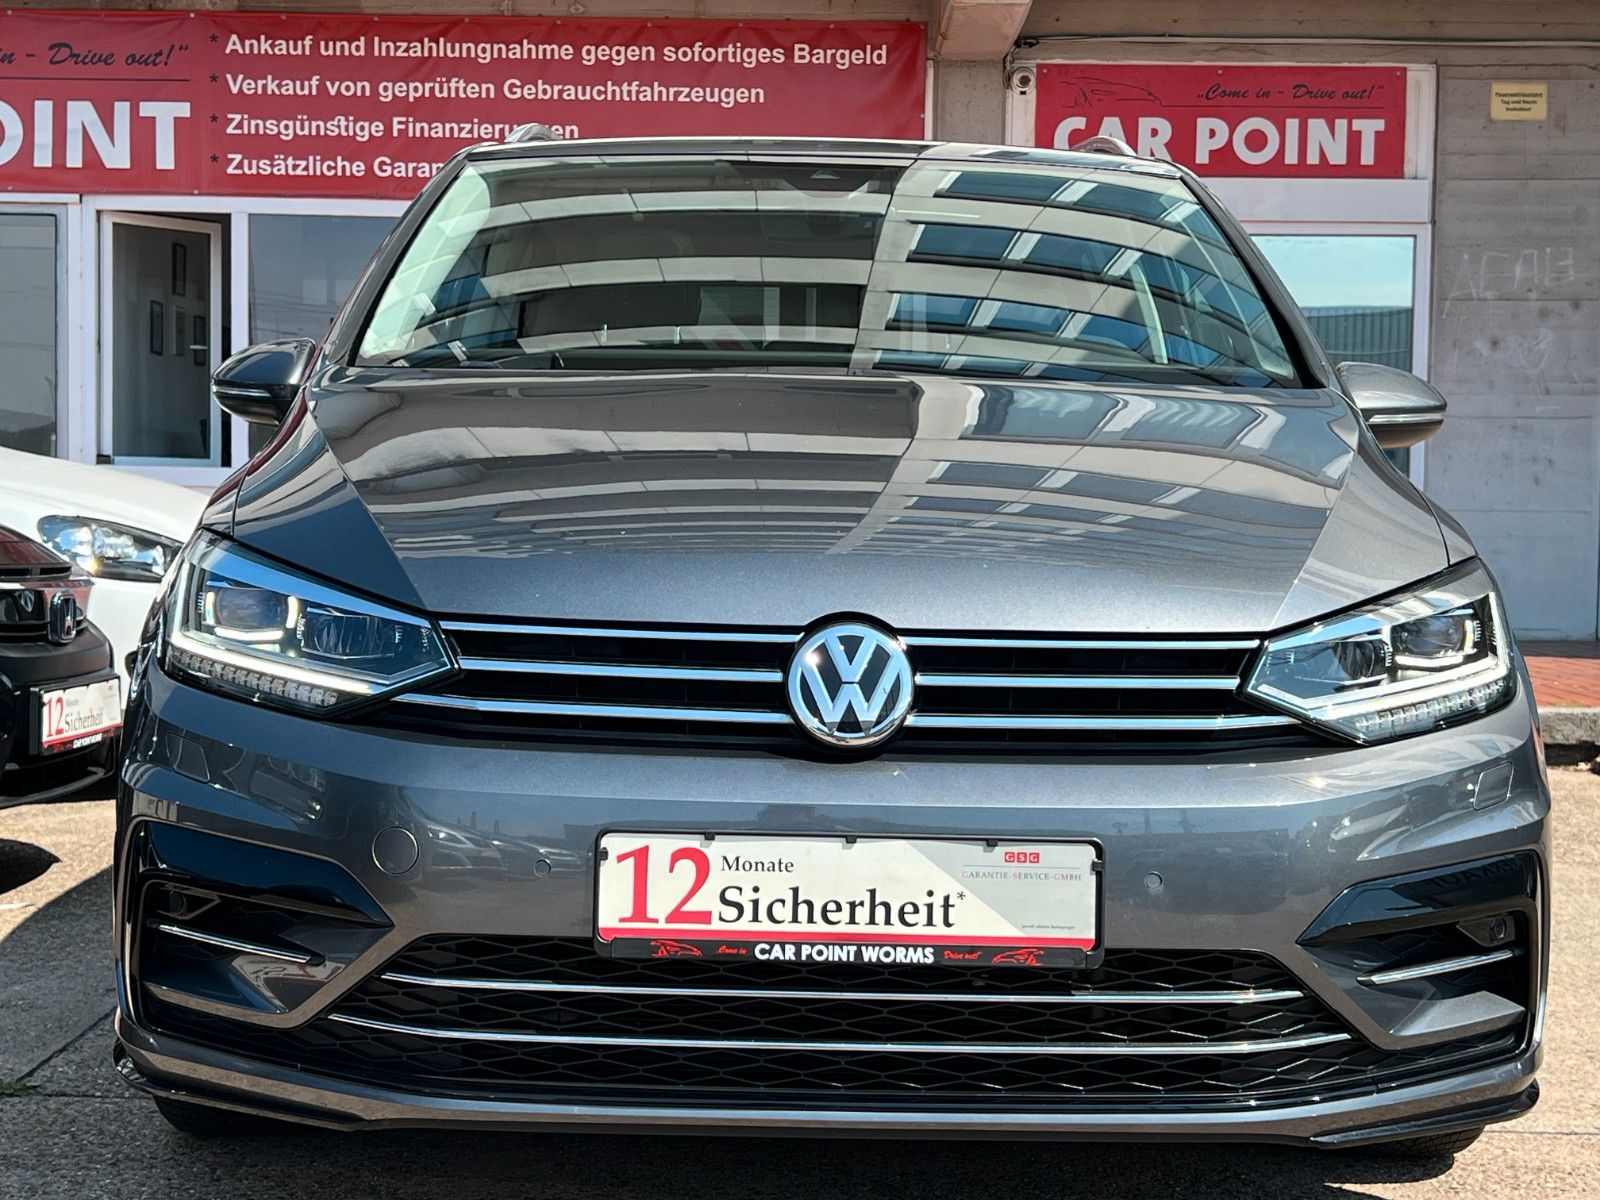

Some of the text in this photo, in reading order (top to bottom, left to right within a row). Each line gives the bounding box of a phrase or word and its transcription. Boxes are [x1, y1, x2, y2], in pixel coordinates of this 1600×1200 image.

[48, 42, 115, 66] Drive
[225, 34, 888, 70] Ankauf und Inzahlungnahme gegen sofortiges Bargeld
[225, 74, 765, 108] Verkauf von geprüften Gebrauchtfahrzeugen
[1256, 87, 1271, 99] in
[1292, 83, 1337, 100] Drive
[226, 113, 579, 141] Zinsgünstige Finanzieren
[1195, 116, 1385, 166] POINT
[226, 153, 366, 176] Zusätzliche
[46, 695, 65, 738] 12
[1004, 851, 1040, 864] GSG
[615, 844, 795, 925] 12 Monate
[754, 942, 935, 964] CAR POINT WORMS
